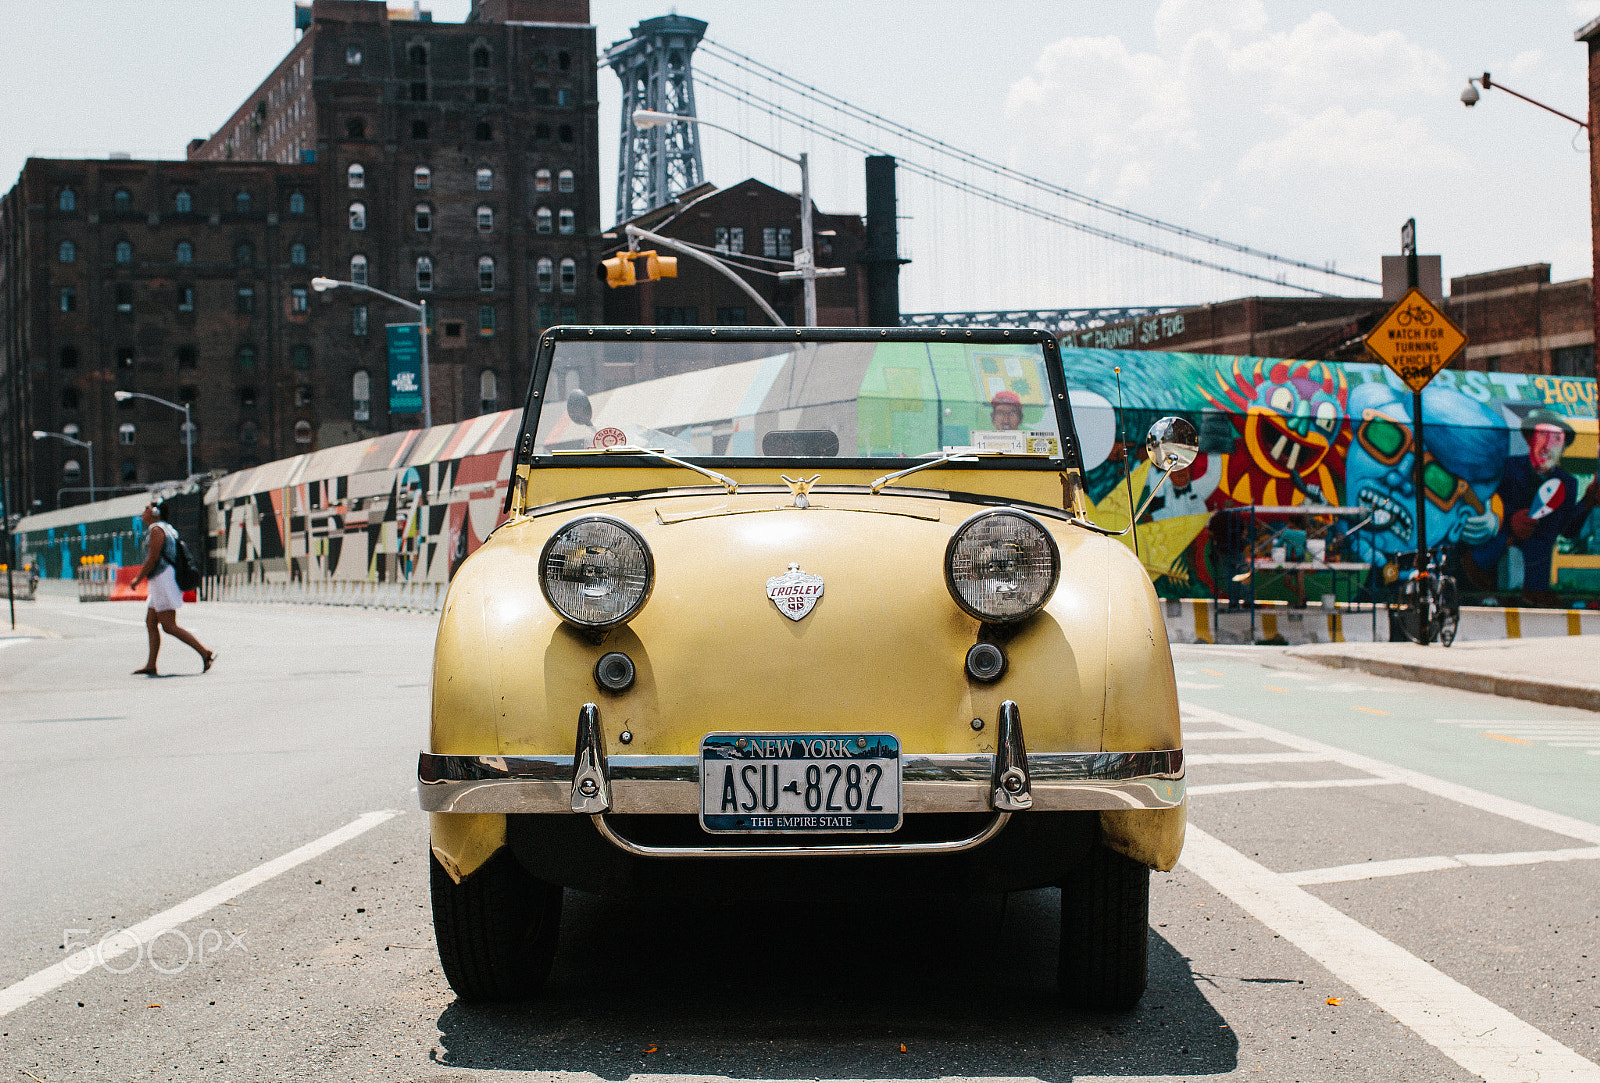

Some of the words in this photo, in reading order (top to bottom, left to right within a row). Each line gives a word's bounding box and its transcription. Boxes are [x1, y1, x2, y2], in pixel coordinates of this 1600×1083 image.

[1388, 329, 1421, 339] WATCH
[1424, 328, 1444, 338] FOR
[1395, 341, 1439, 353] TURNING
[1393, 354, 1441, 365] VEHICLES
[1010, 441, 1023, 450] 14
[771, 585, 821, 597] CROSLEY
[750, 739, 795, 758] NEW
[800, 739, 852, 758] YORK
[720, 764, 779, 812] ASU
[804, 763, 883, 812] 8282
[751, 817, 774, 827] THE
[777, 816, 820, 827] EMPIRE
[820, 816, 852, 827] STATE
